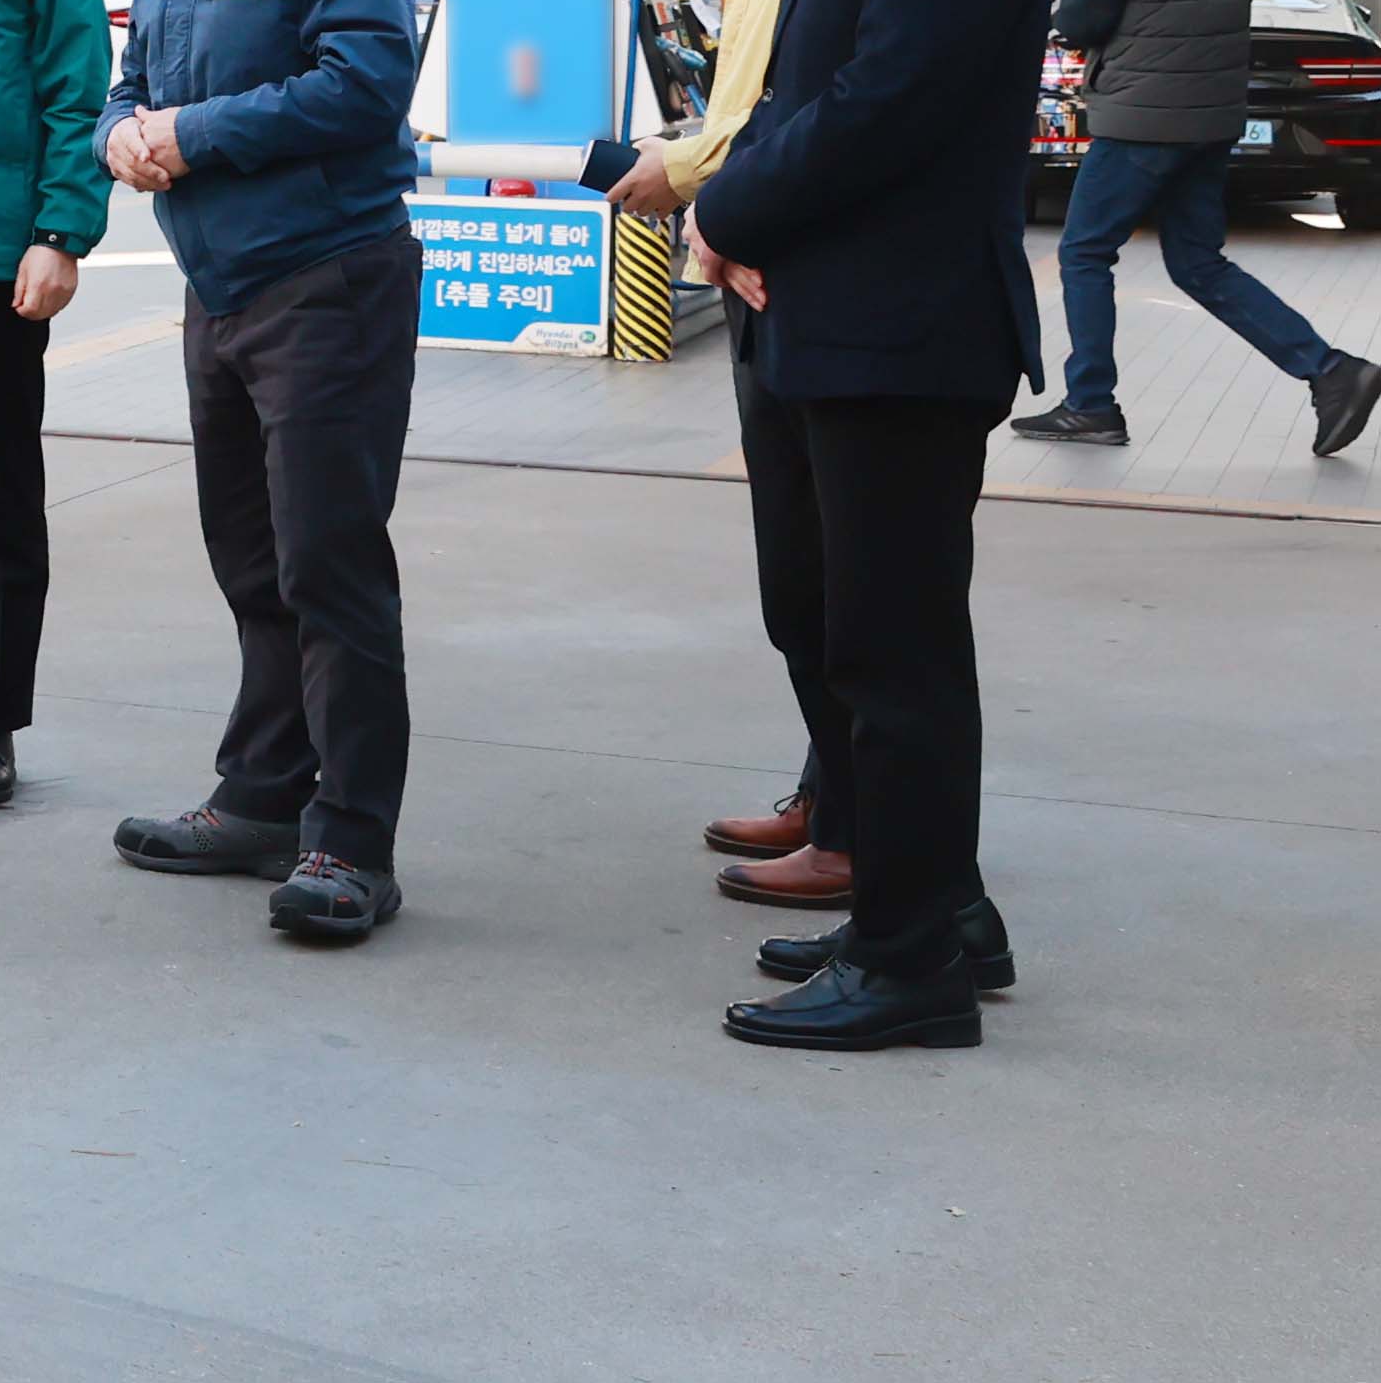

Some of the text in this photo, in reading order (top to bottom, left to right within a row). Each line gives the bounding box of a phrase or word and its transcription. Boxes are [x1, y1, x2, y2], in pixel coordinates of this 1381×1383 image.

[549, 224, 590, 247] 돌아
[435, 279, 553, 313] [추돌 주의]
